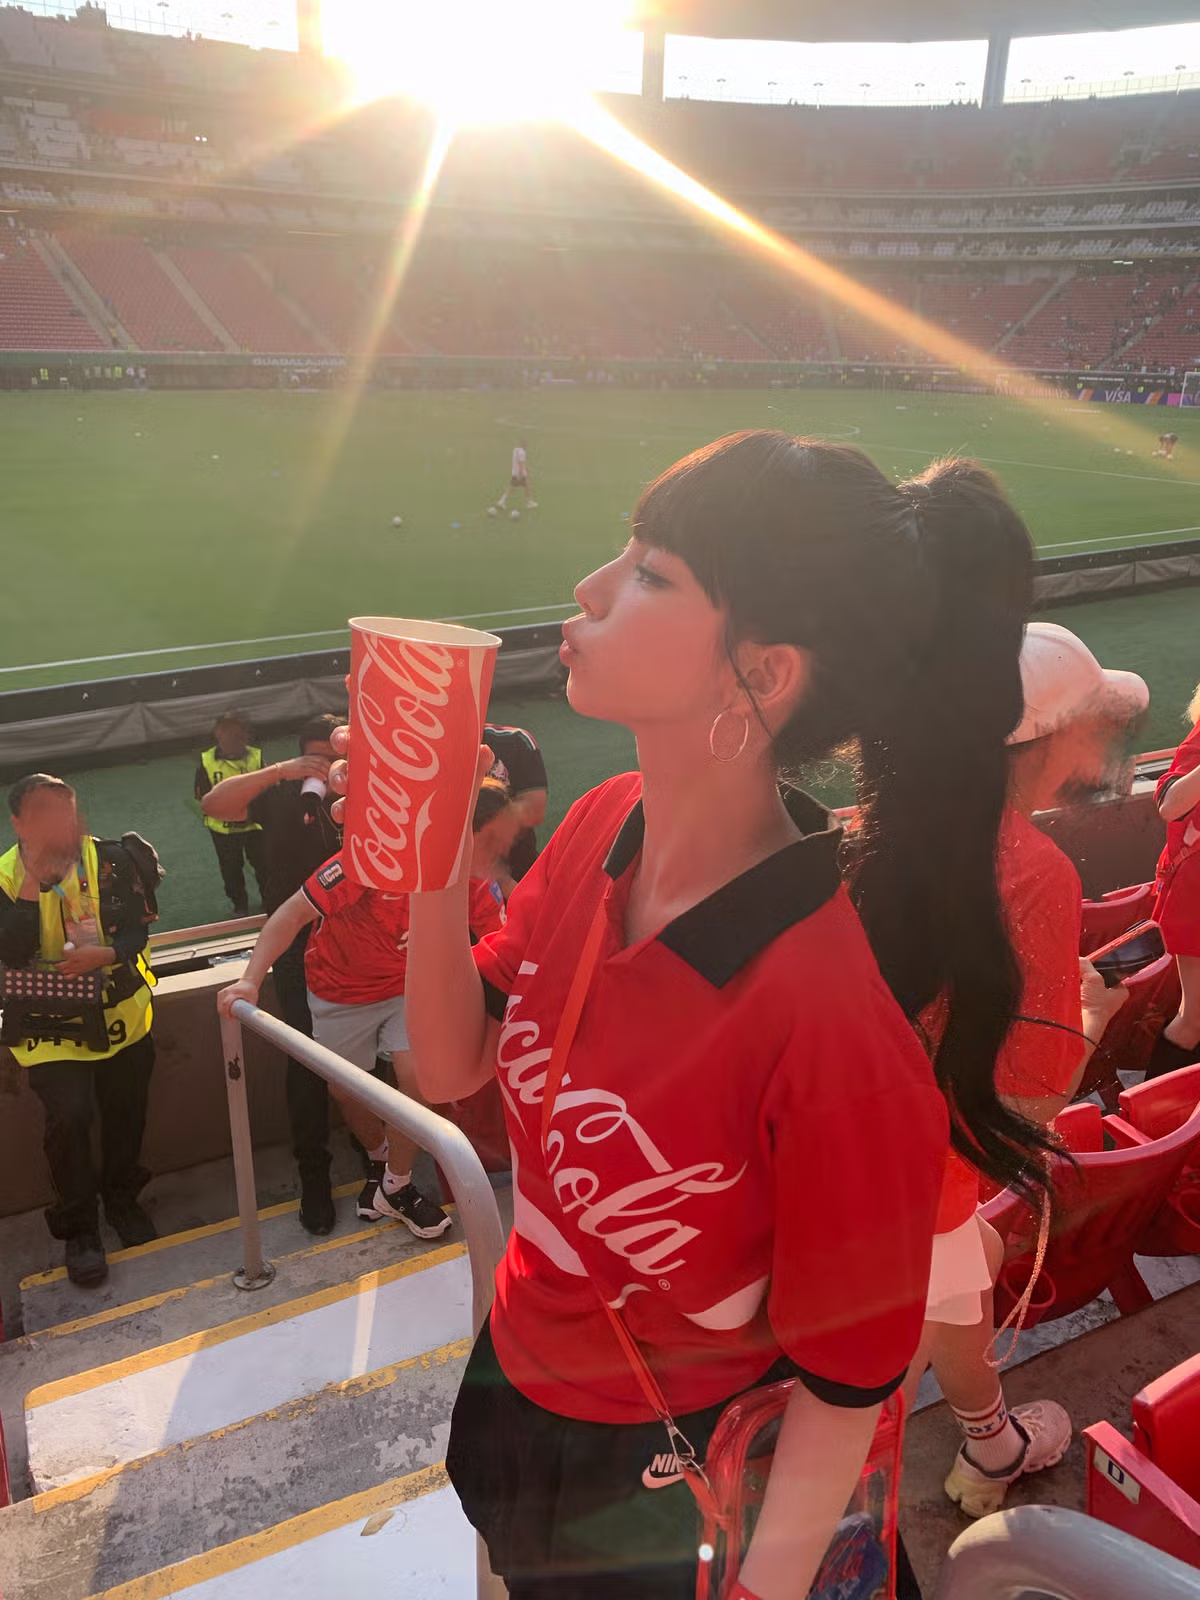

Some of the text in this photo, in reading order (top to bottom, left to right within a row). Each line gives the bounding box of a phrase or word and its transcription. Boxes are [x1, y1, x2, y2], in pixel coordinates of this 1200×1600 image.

[1104, 389, 1132, 404] VISA
[650, 1453, 692, 1473] NIK
[1107, 1459, 1125, 1485] D
